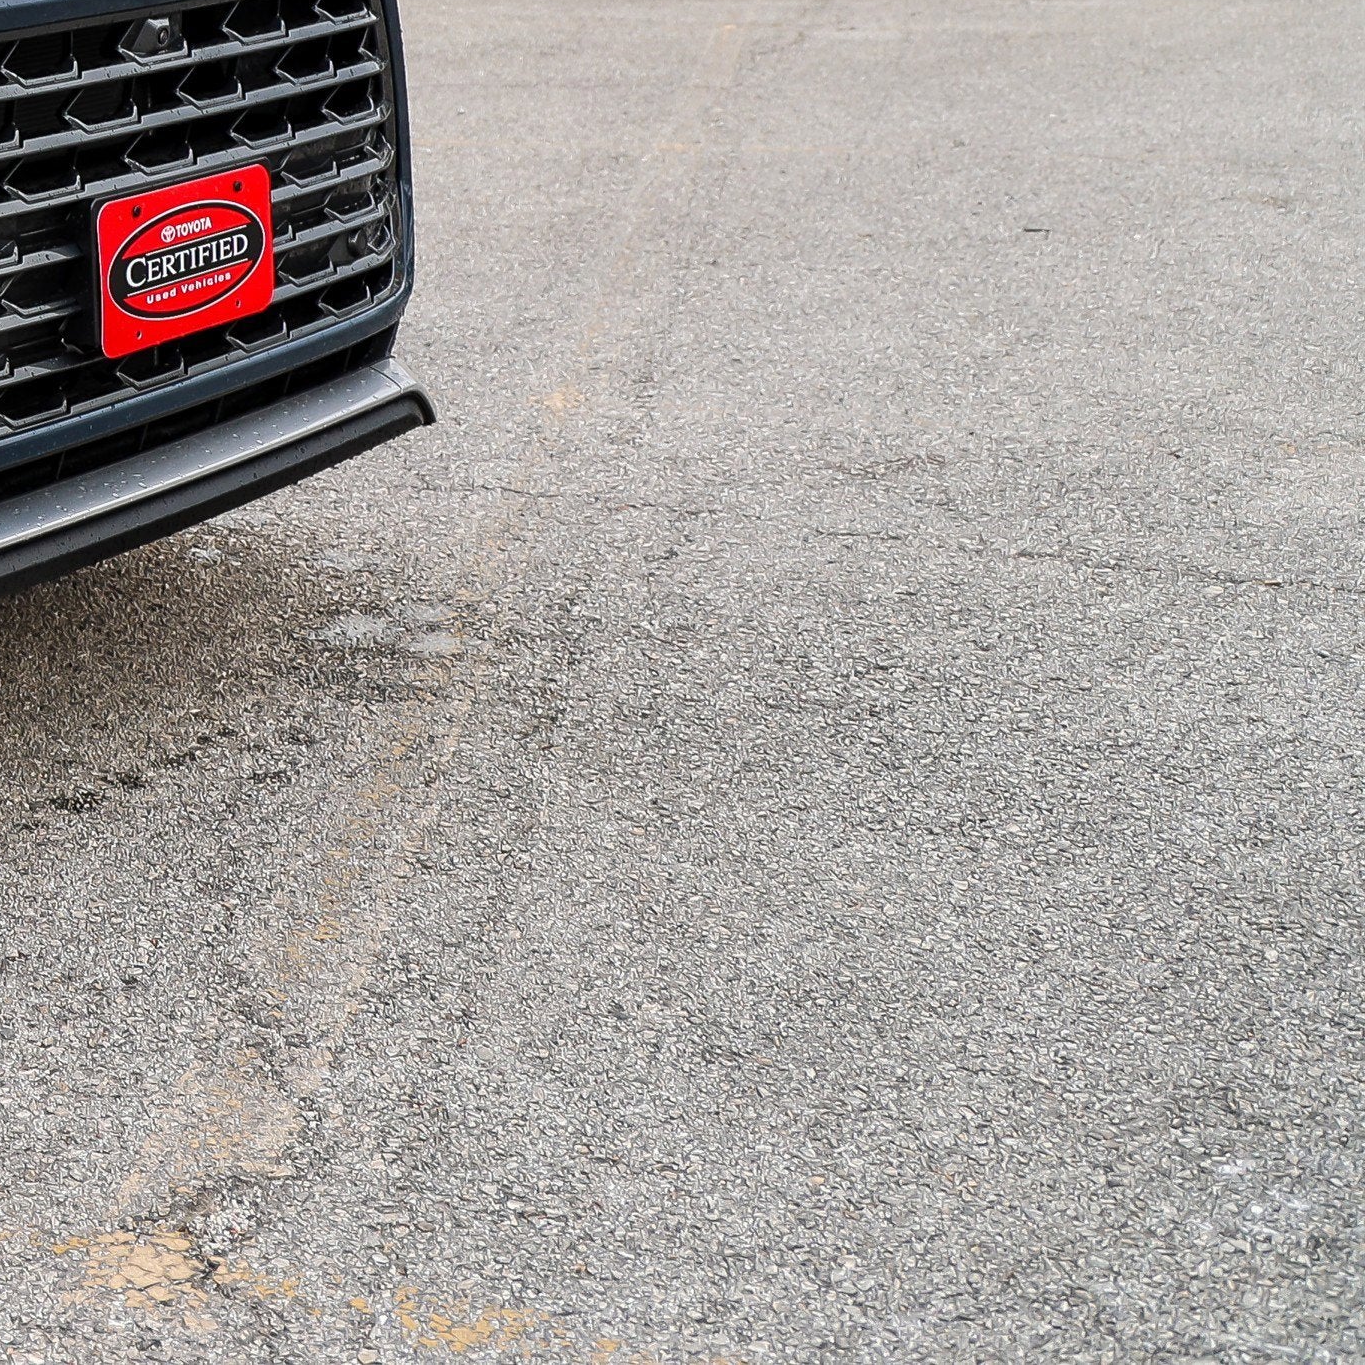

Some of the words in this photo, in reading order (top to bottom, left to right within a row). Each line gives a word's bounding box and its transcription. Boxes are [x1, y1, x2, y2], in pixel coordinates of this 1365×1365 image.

[176, 217, 212, 237] TOYOTA
[126, 233, 248, 287] CERTIFIED
[147, 288, 176, 304] Used
[181, 273, 231, 294] Vehicles
